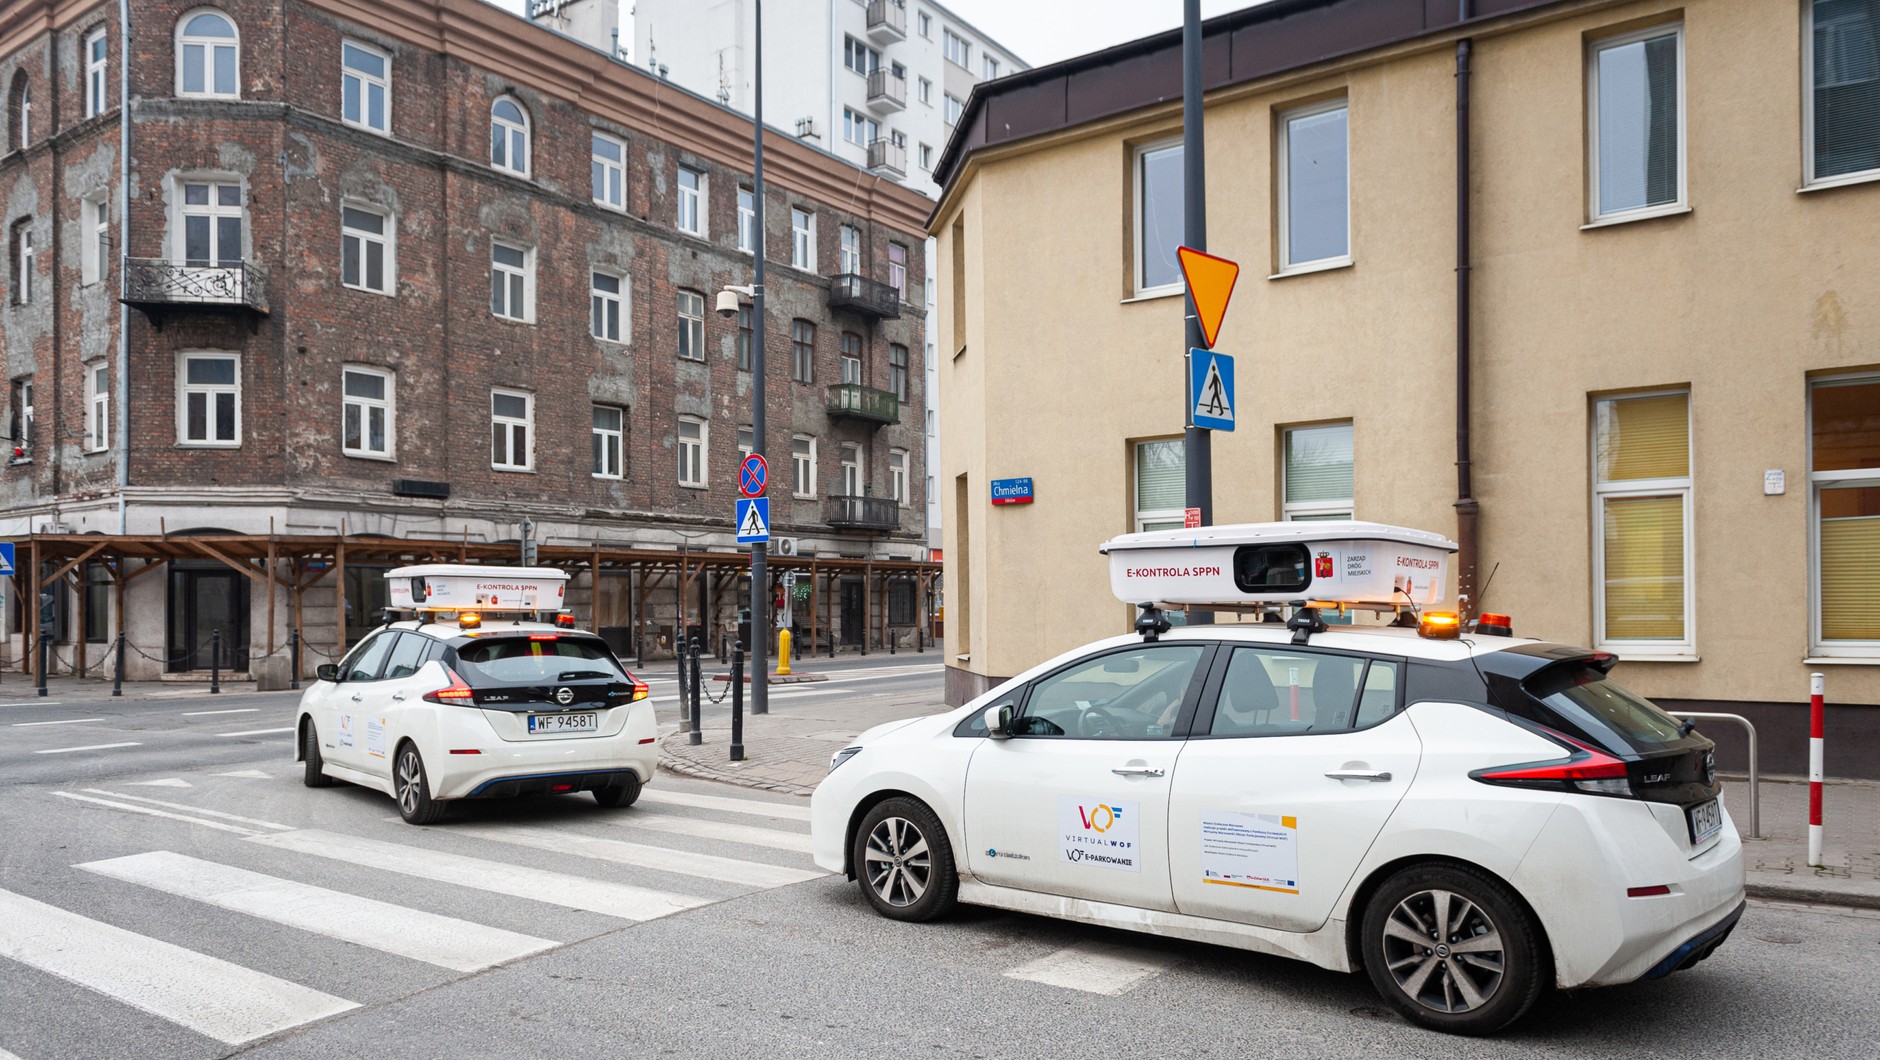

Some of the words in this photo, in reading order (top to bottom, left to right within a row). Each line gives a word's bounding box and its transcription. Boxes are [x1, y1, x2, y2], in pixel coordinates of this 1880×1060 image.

[993, 484, 1029, 497] Chmielna
[1347, 562, 1362, 570] DRÓG
[1396, 556, 1428, 570] E-KONTROLA
[1428, 559, 1440, 570] SPPN
[1126, 567, 1190, 578] E-KONTROLA
[1192, 566, 1220, 577] SPPN
[476, 583, 519, 591] E-KONTROLA
[520, 584, 538, 592] SPPN
[537, 716, 553, 730] WF
[557, 714, 594, 729] 9458T
[1643, 773, 1671, 784] LEAF
[1085, 854, 1133, 867] E-PARKOWANIE
